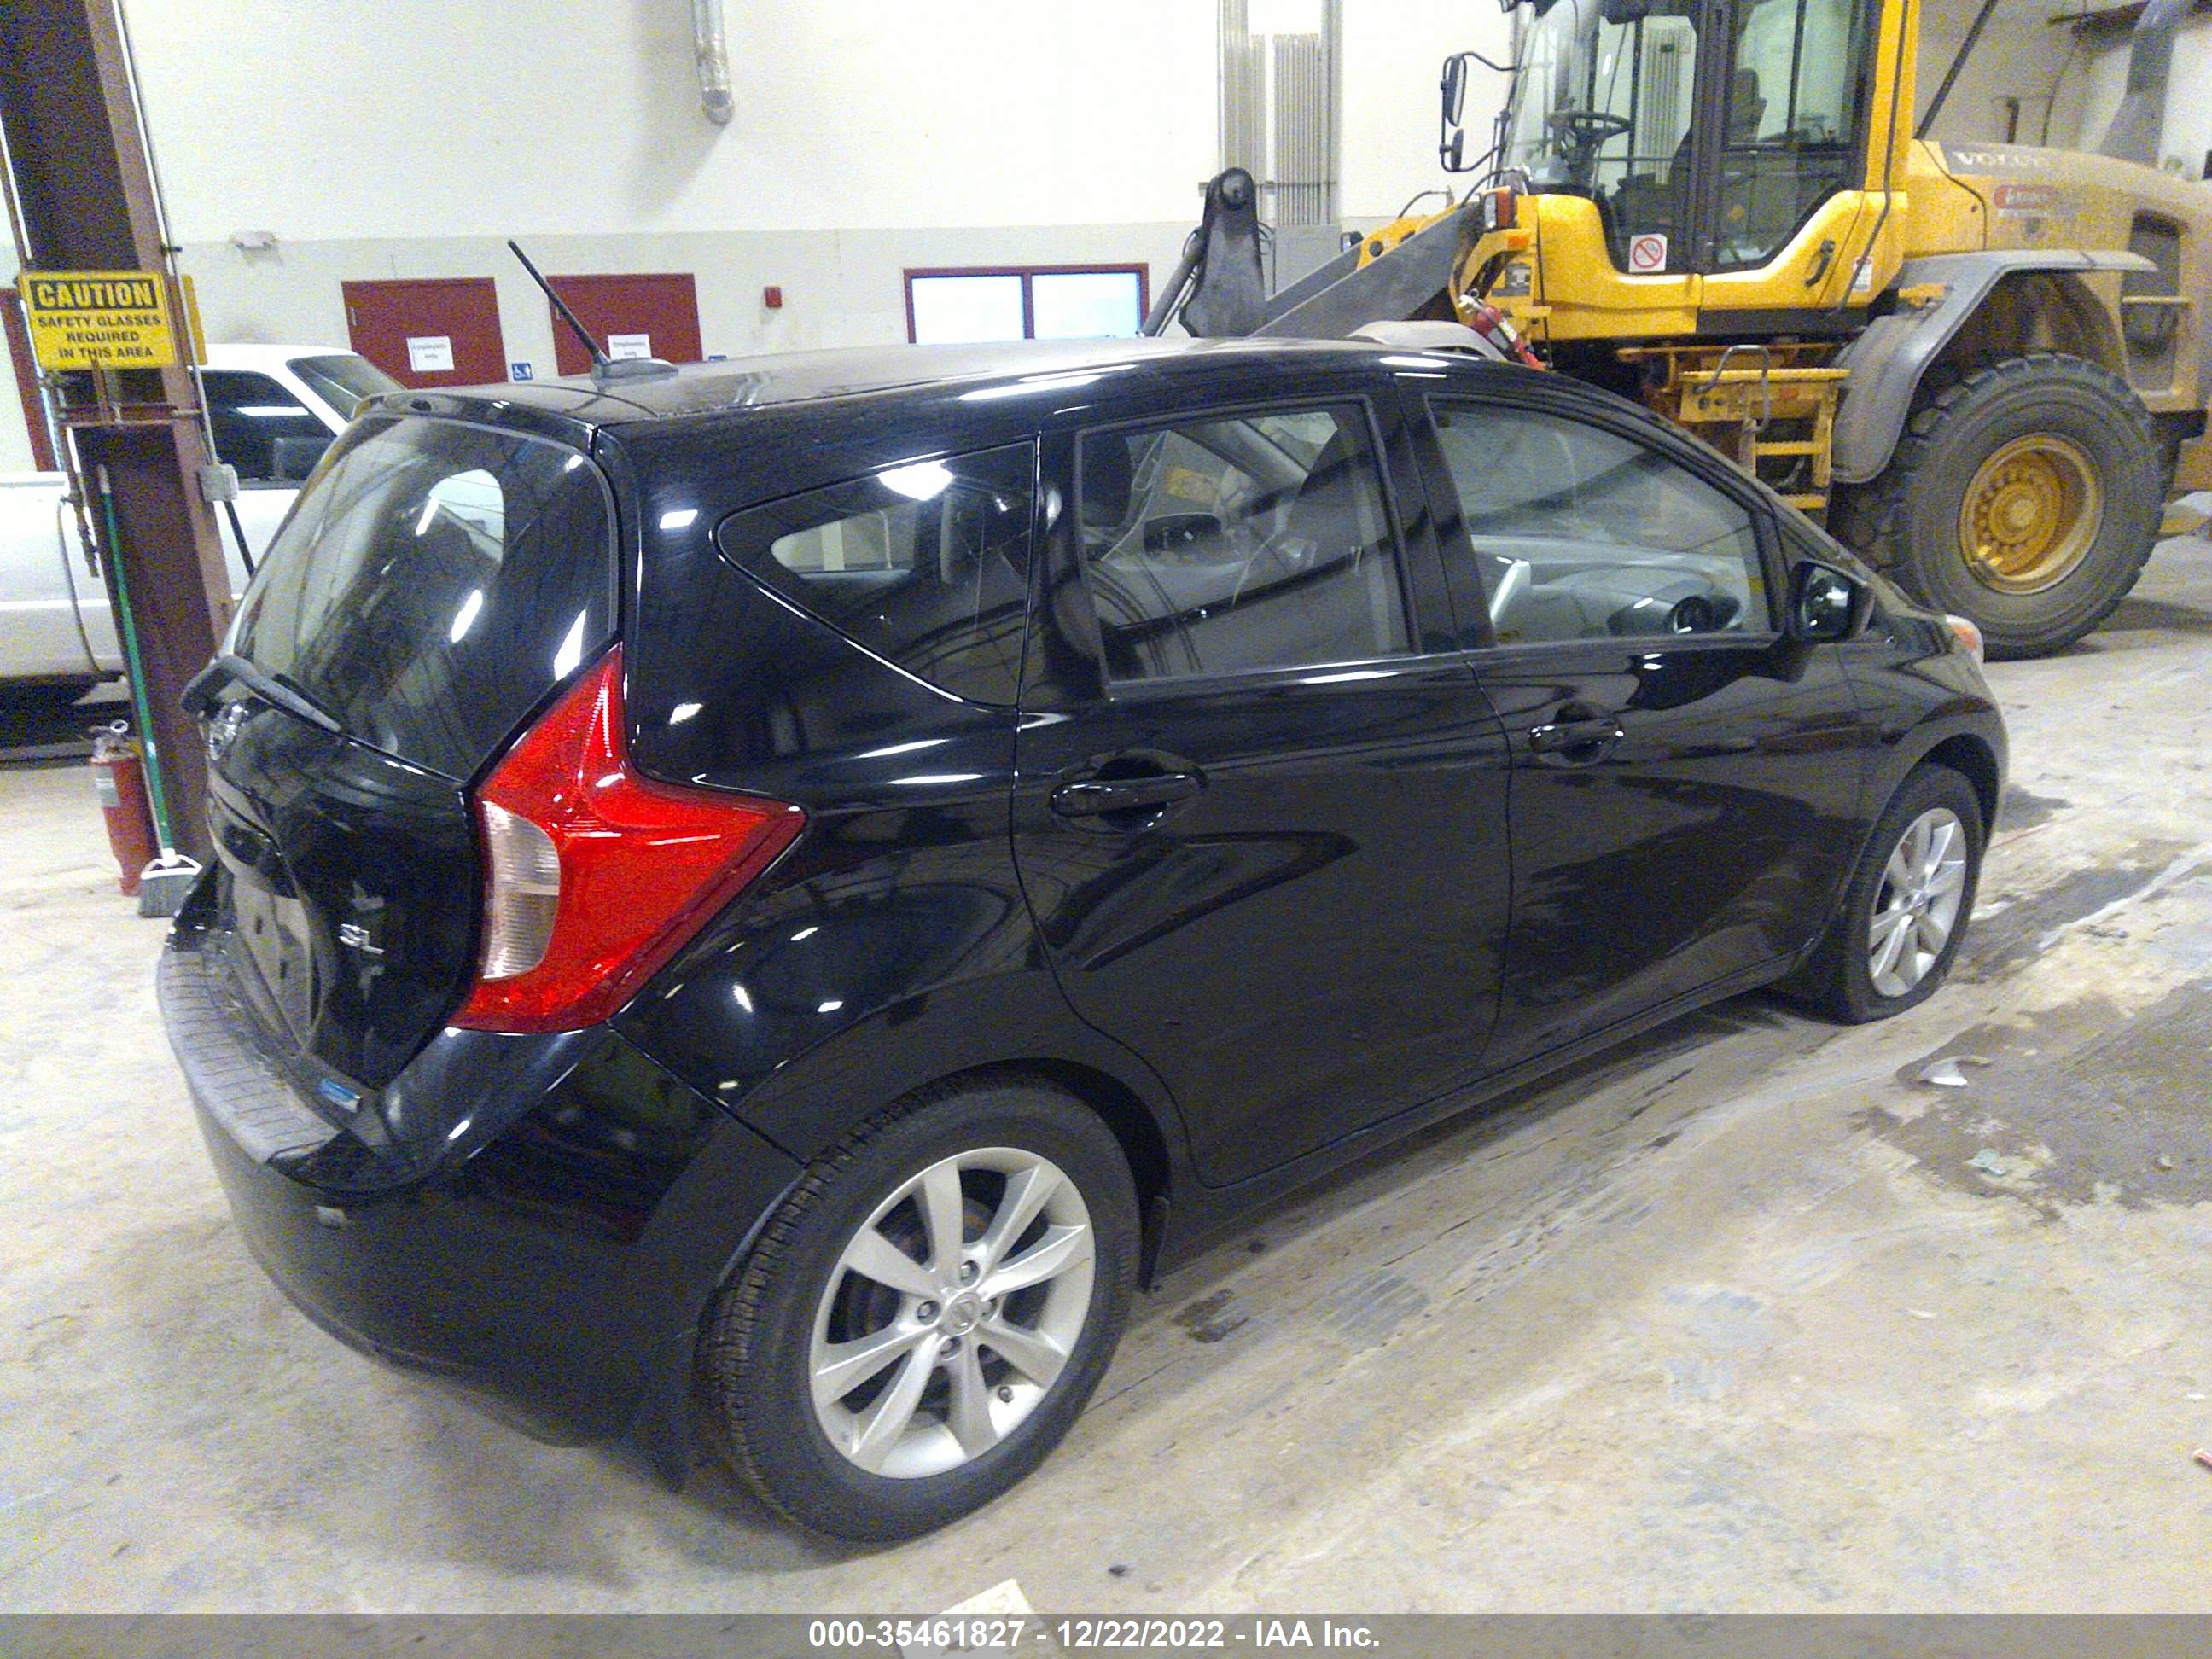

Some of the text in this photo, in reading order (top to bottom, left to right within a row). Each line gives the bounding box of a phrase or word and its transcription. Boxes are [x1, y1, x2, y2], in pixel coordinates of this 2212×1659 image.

[38, 282, 153, 307] CAUTION
[38, 314, 160, 328] SAFETY GLASSES
[66, 331, 140, 342] REQUIRED
[59, 348, 153, 358] IN THIS AREA
